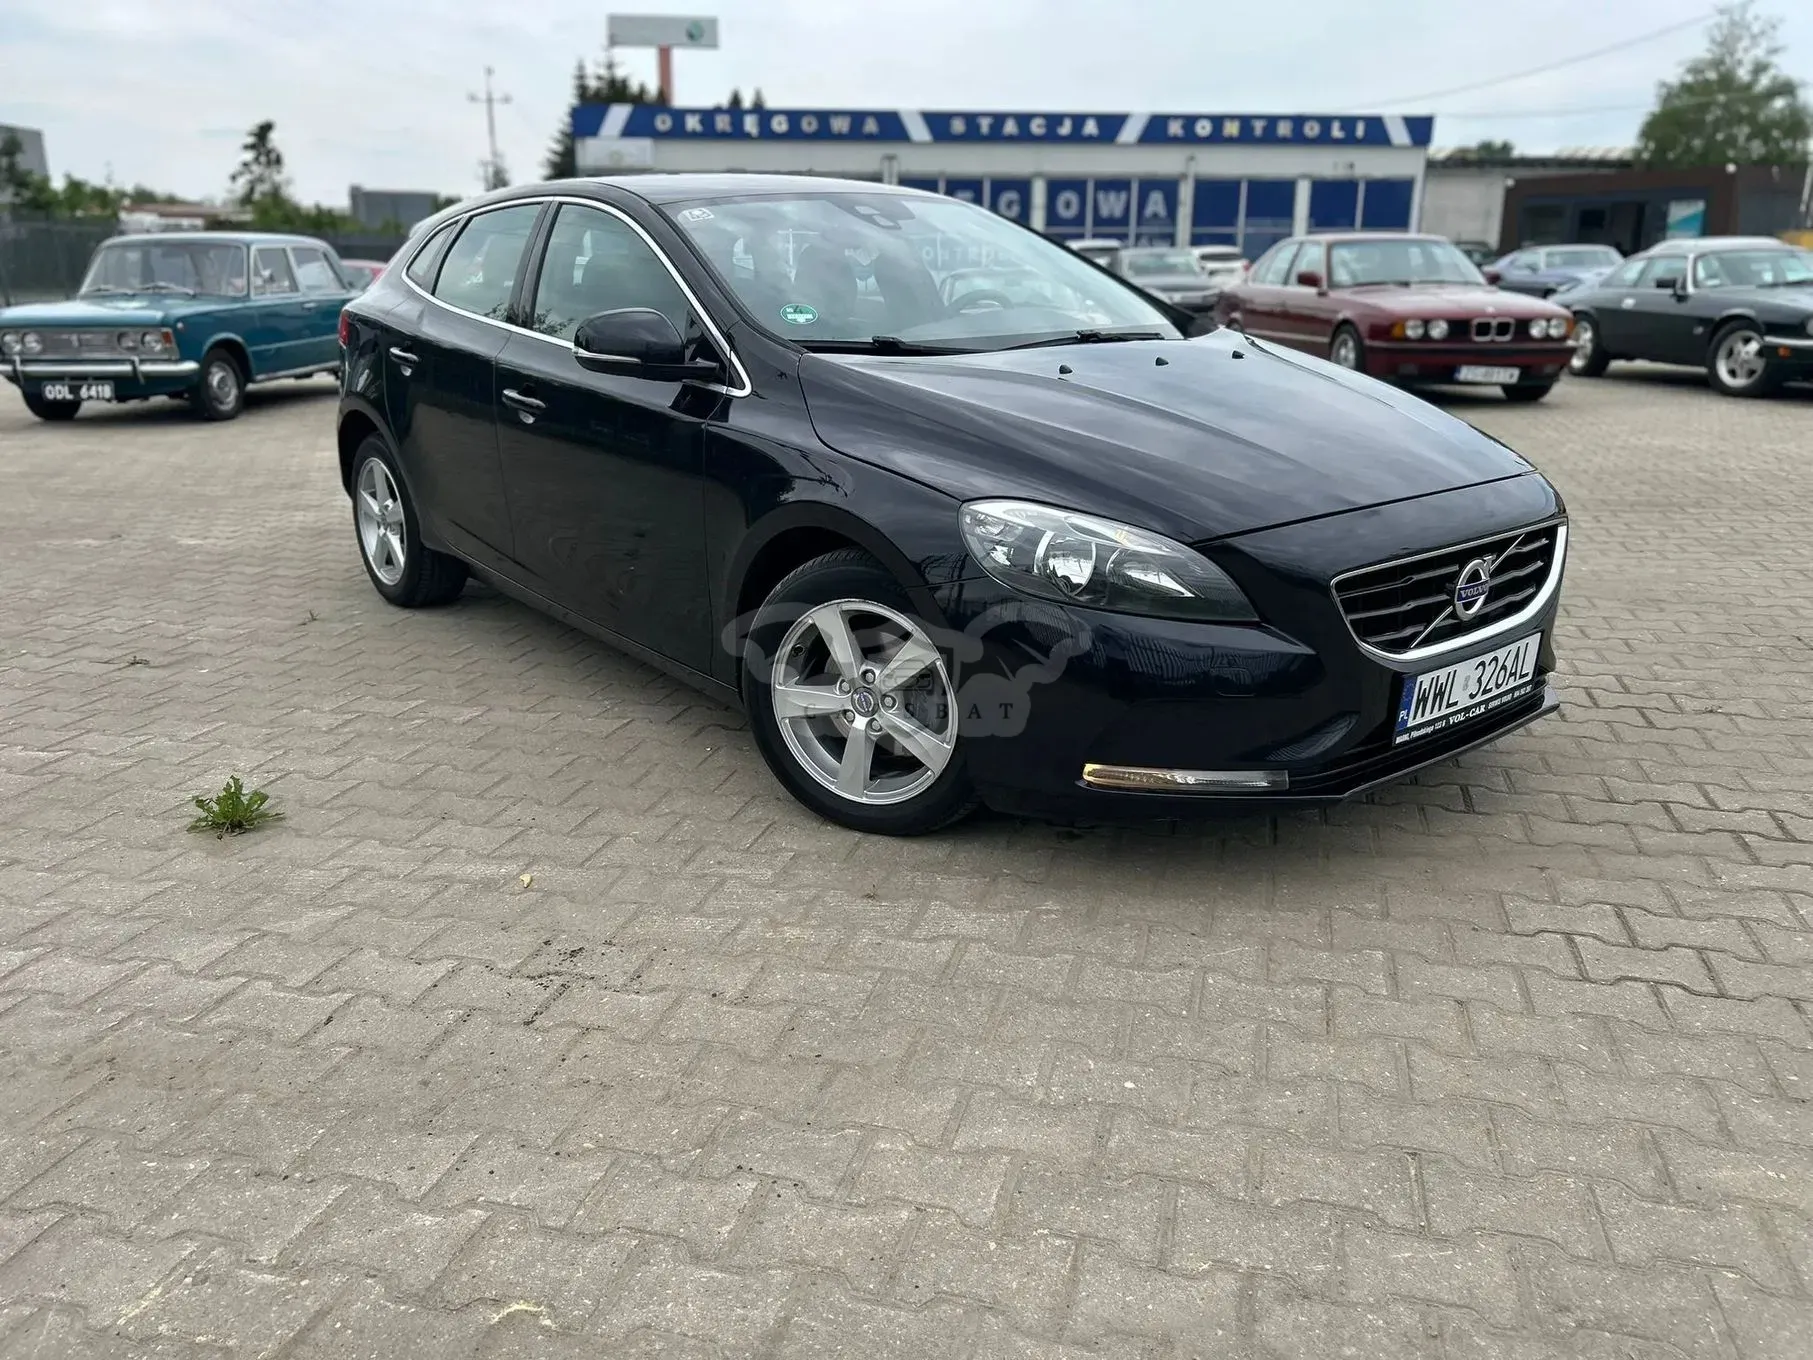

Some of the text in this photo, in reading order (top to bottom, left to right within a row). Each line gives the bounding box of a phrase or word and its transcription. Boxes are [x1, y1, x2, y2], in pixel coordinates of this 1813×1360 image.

[654, 113, 1366, 139] OKRĘGOWA STACJA KONTROLI
[953, 190, 1168, 219] GOWA
[1460, 583, 1489, 598] VOLVO
[1412, 668, 1459, 721] WWL
[1469, 641, 1531, 700] 326AL
[1398, 709, 1409, 723] PL
[1448, 704, 1486, 726] VOL-CAR
